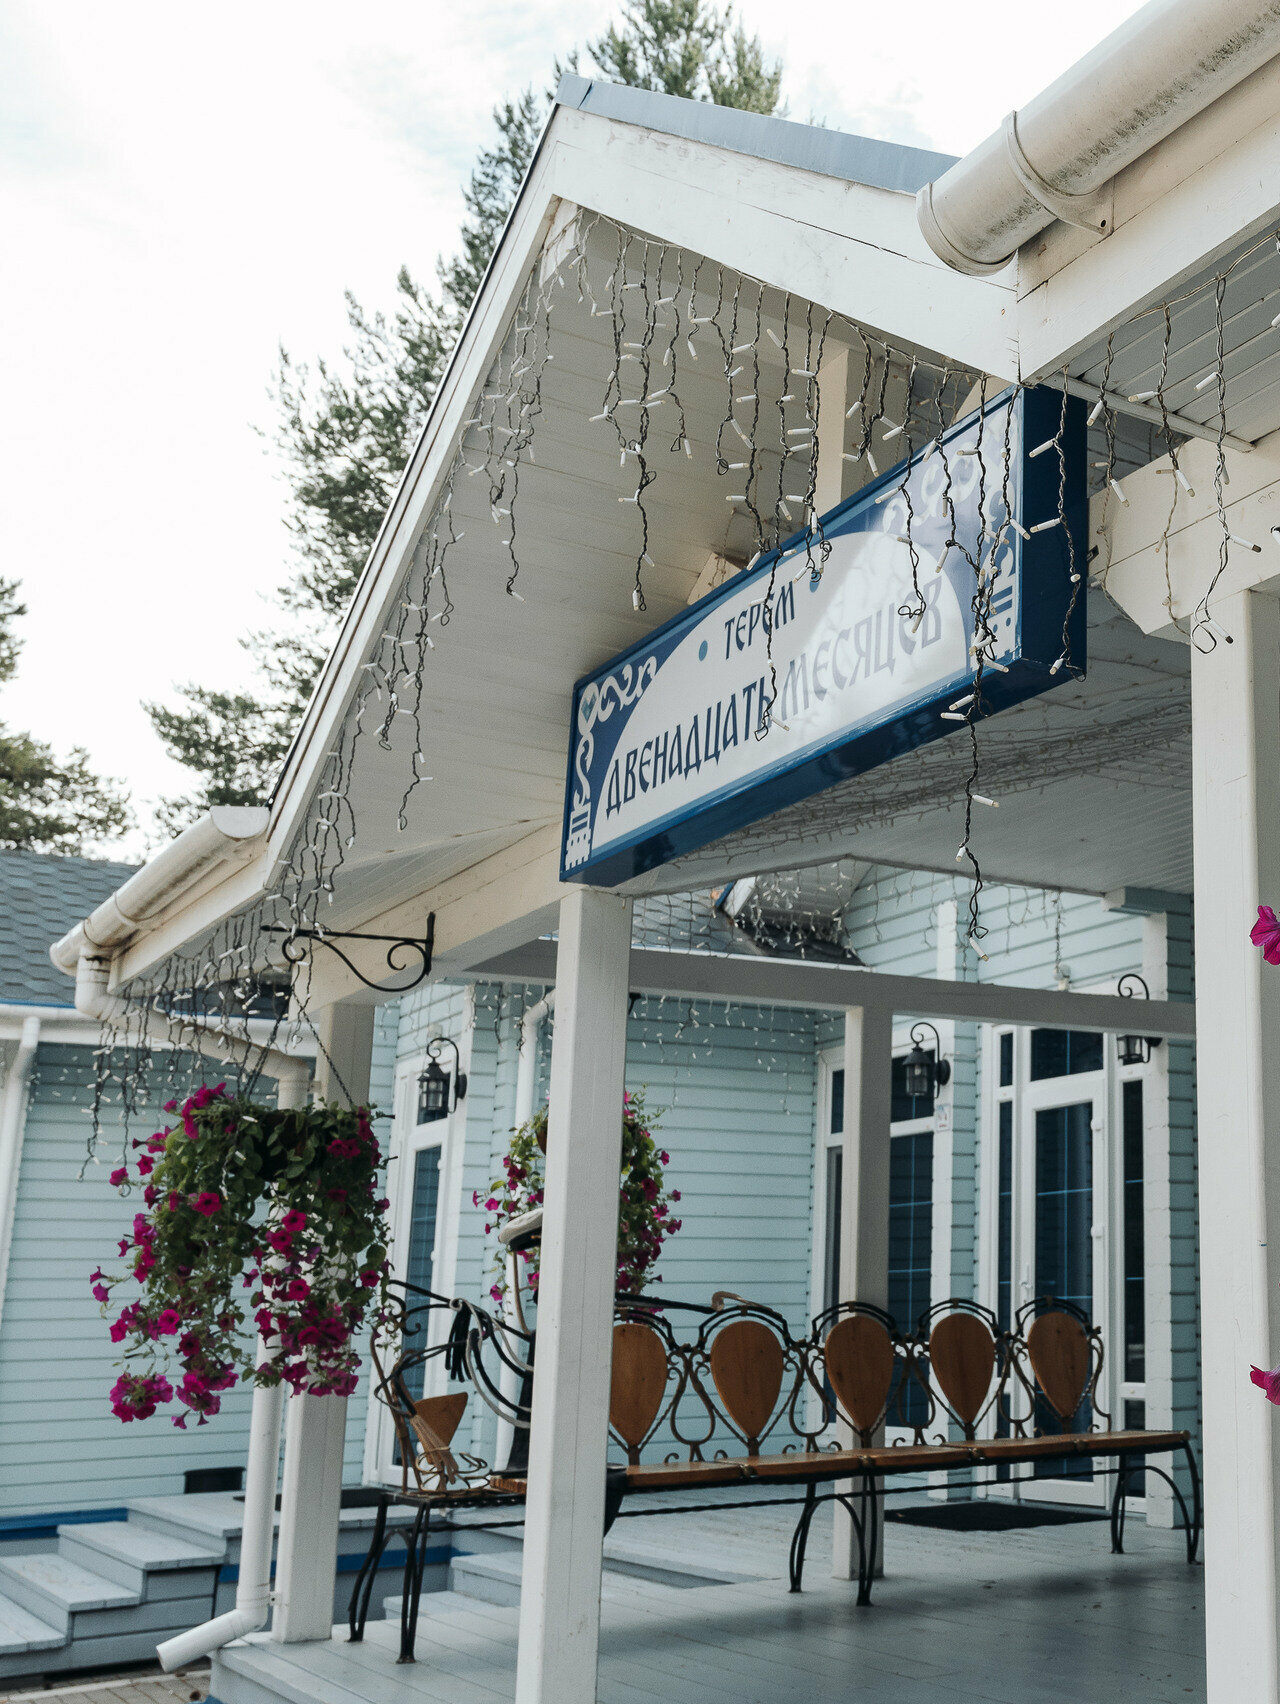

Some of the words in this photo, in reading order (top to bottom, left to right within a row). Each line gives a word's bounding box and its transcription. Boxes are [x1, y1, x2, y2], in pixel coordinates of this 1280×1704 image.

[606, 676, 773, 820] ДВЕНАДЦАТЬ
[781, 575, 942, 721] МЕСЯЦЕВ
[724, 580, 795, 660] ТЕРЕМ
